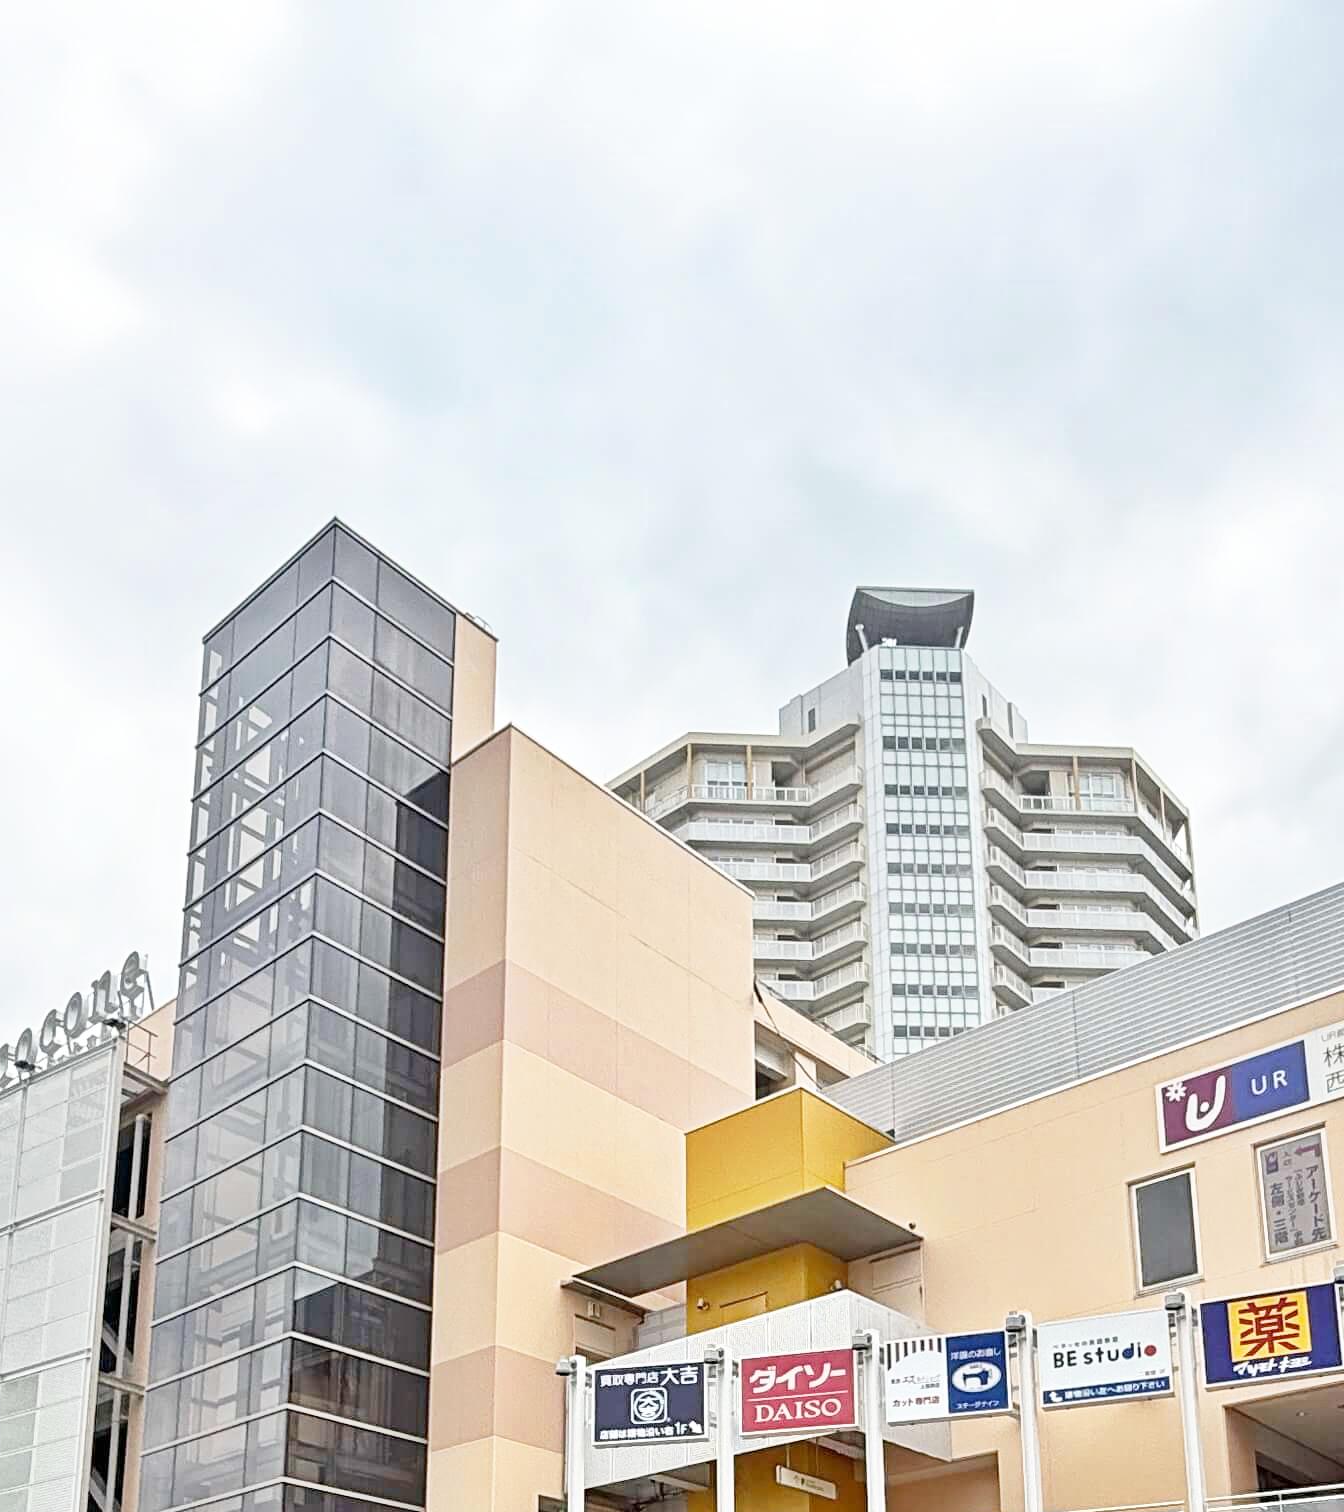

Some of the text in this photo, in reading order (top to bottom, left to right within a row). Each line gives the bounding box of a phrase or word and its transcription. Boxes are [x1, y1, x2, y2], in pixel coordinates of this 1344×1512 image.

[1251, 1070, 1288, 1095] UR
[1306, 1165, 1328, 1241] アーケード先
[1238, 1297, 1300, 1357] 薬
[1053, 1342, 1157, 1369] BE studio
[749, 1362, 846, 1394] ダイソー
[754, 1398, 842, 1423] DAISO
